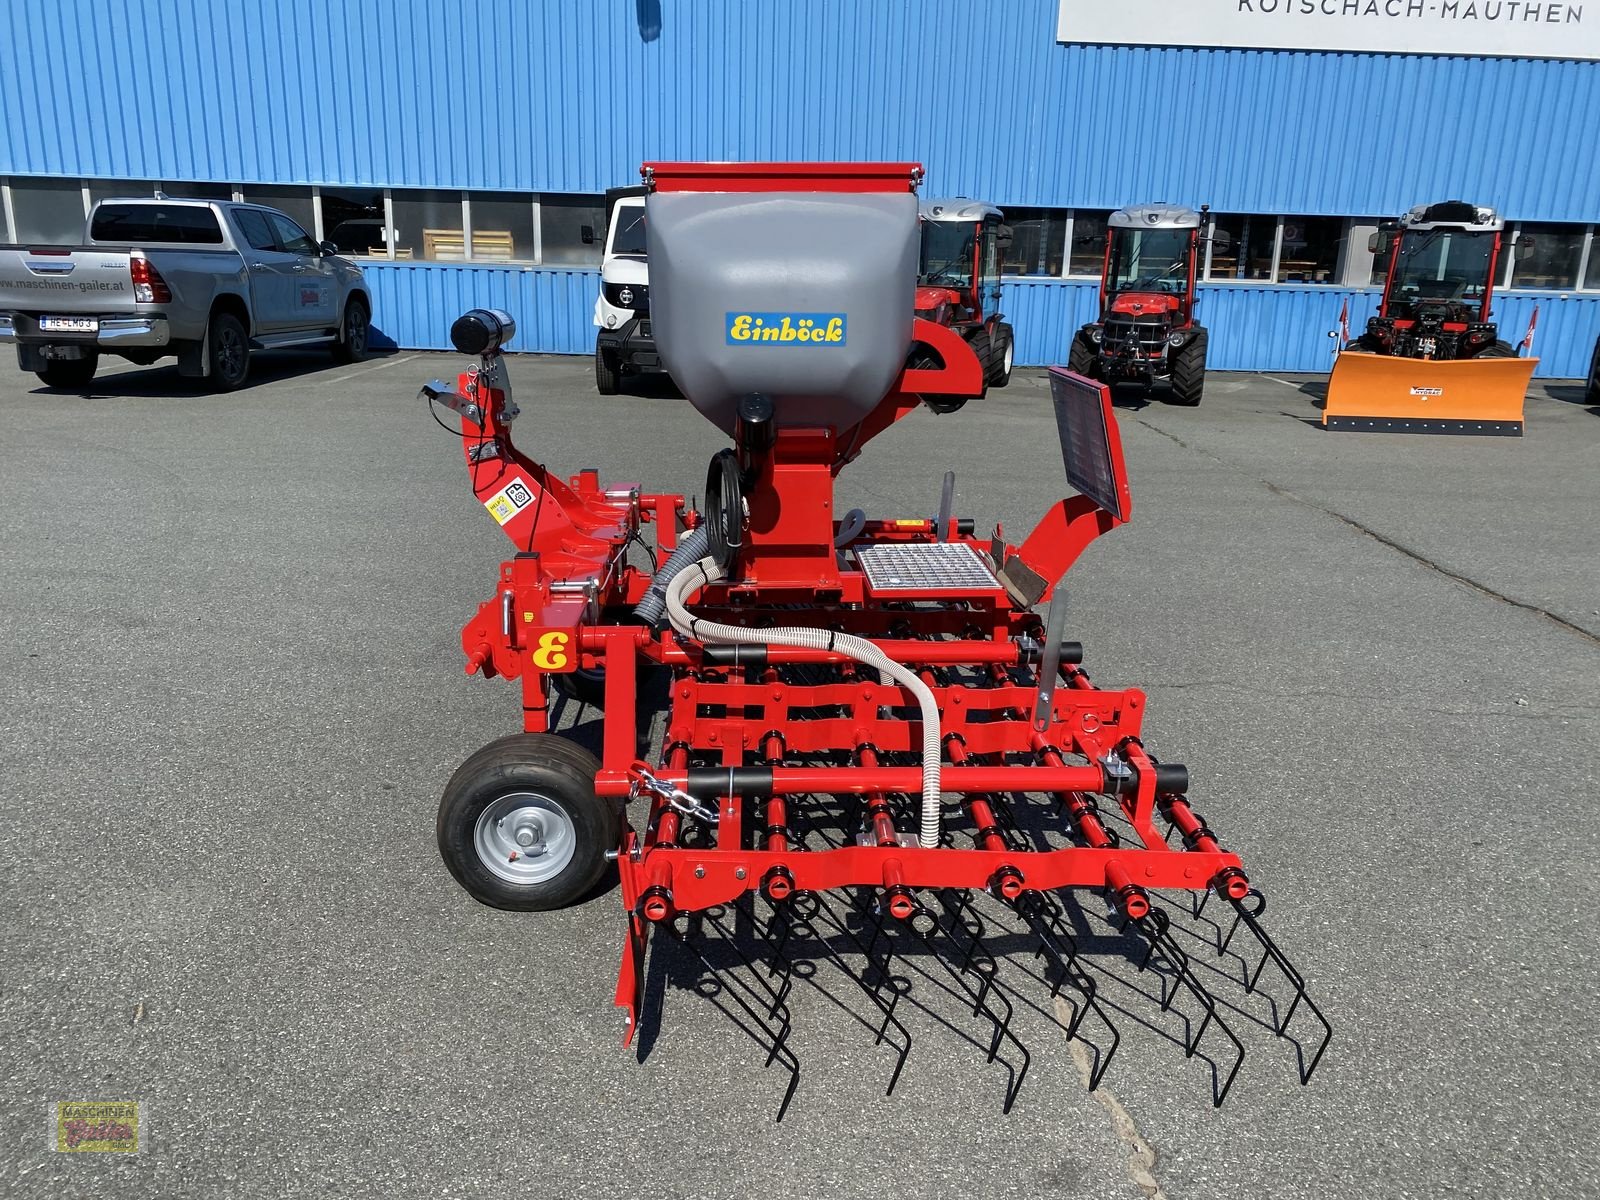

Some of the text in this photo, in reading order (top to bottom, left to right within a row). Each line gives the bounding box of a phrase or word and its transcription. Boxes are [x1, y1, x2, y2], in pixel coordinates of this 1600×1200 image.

[50, 317, 92, 328] HE LMG 3
[731, 315, 842, 341] Einböck
